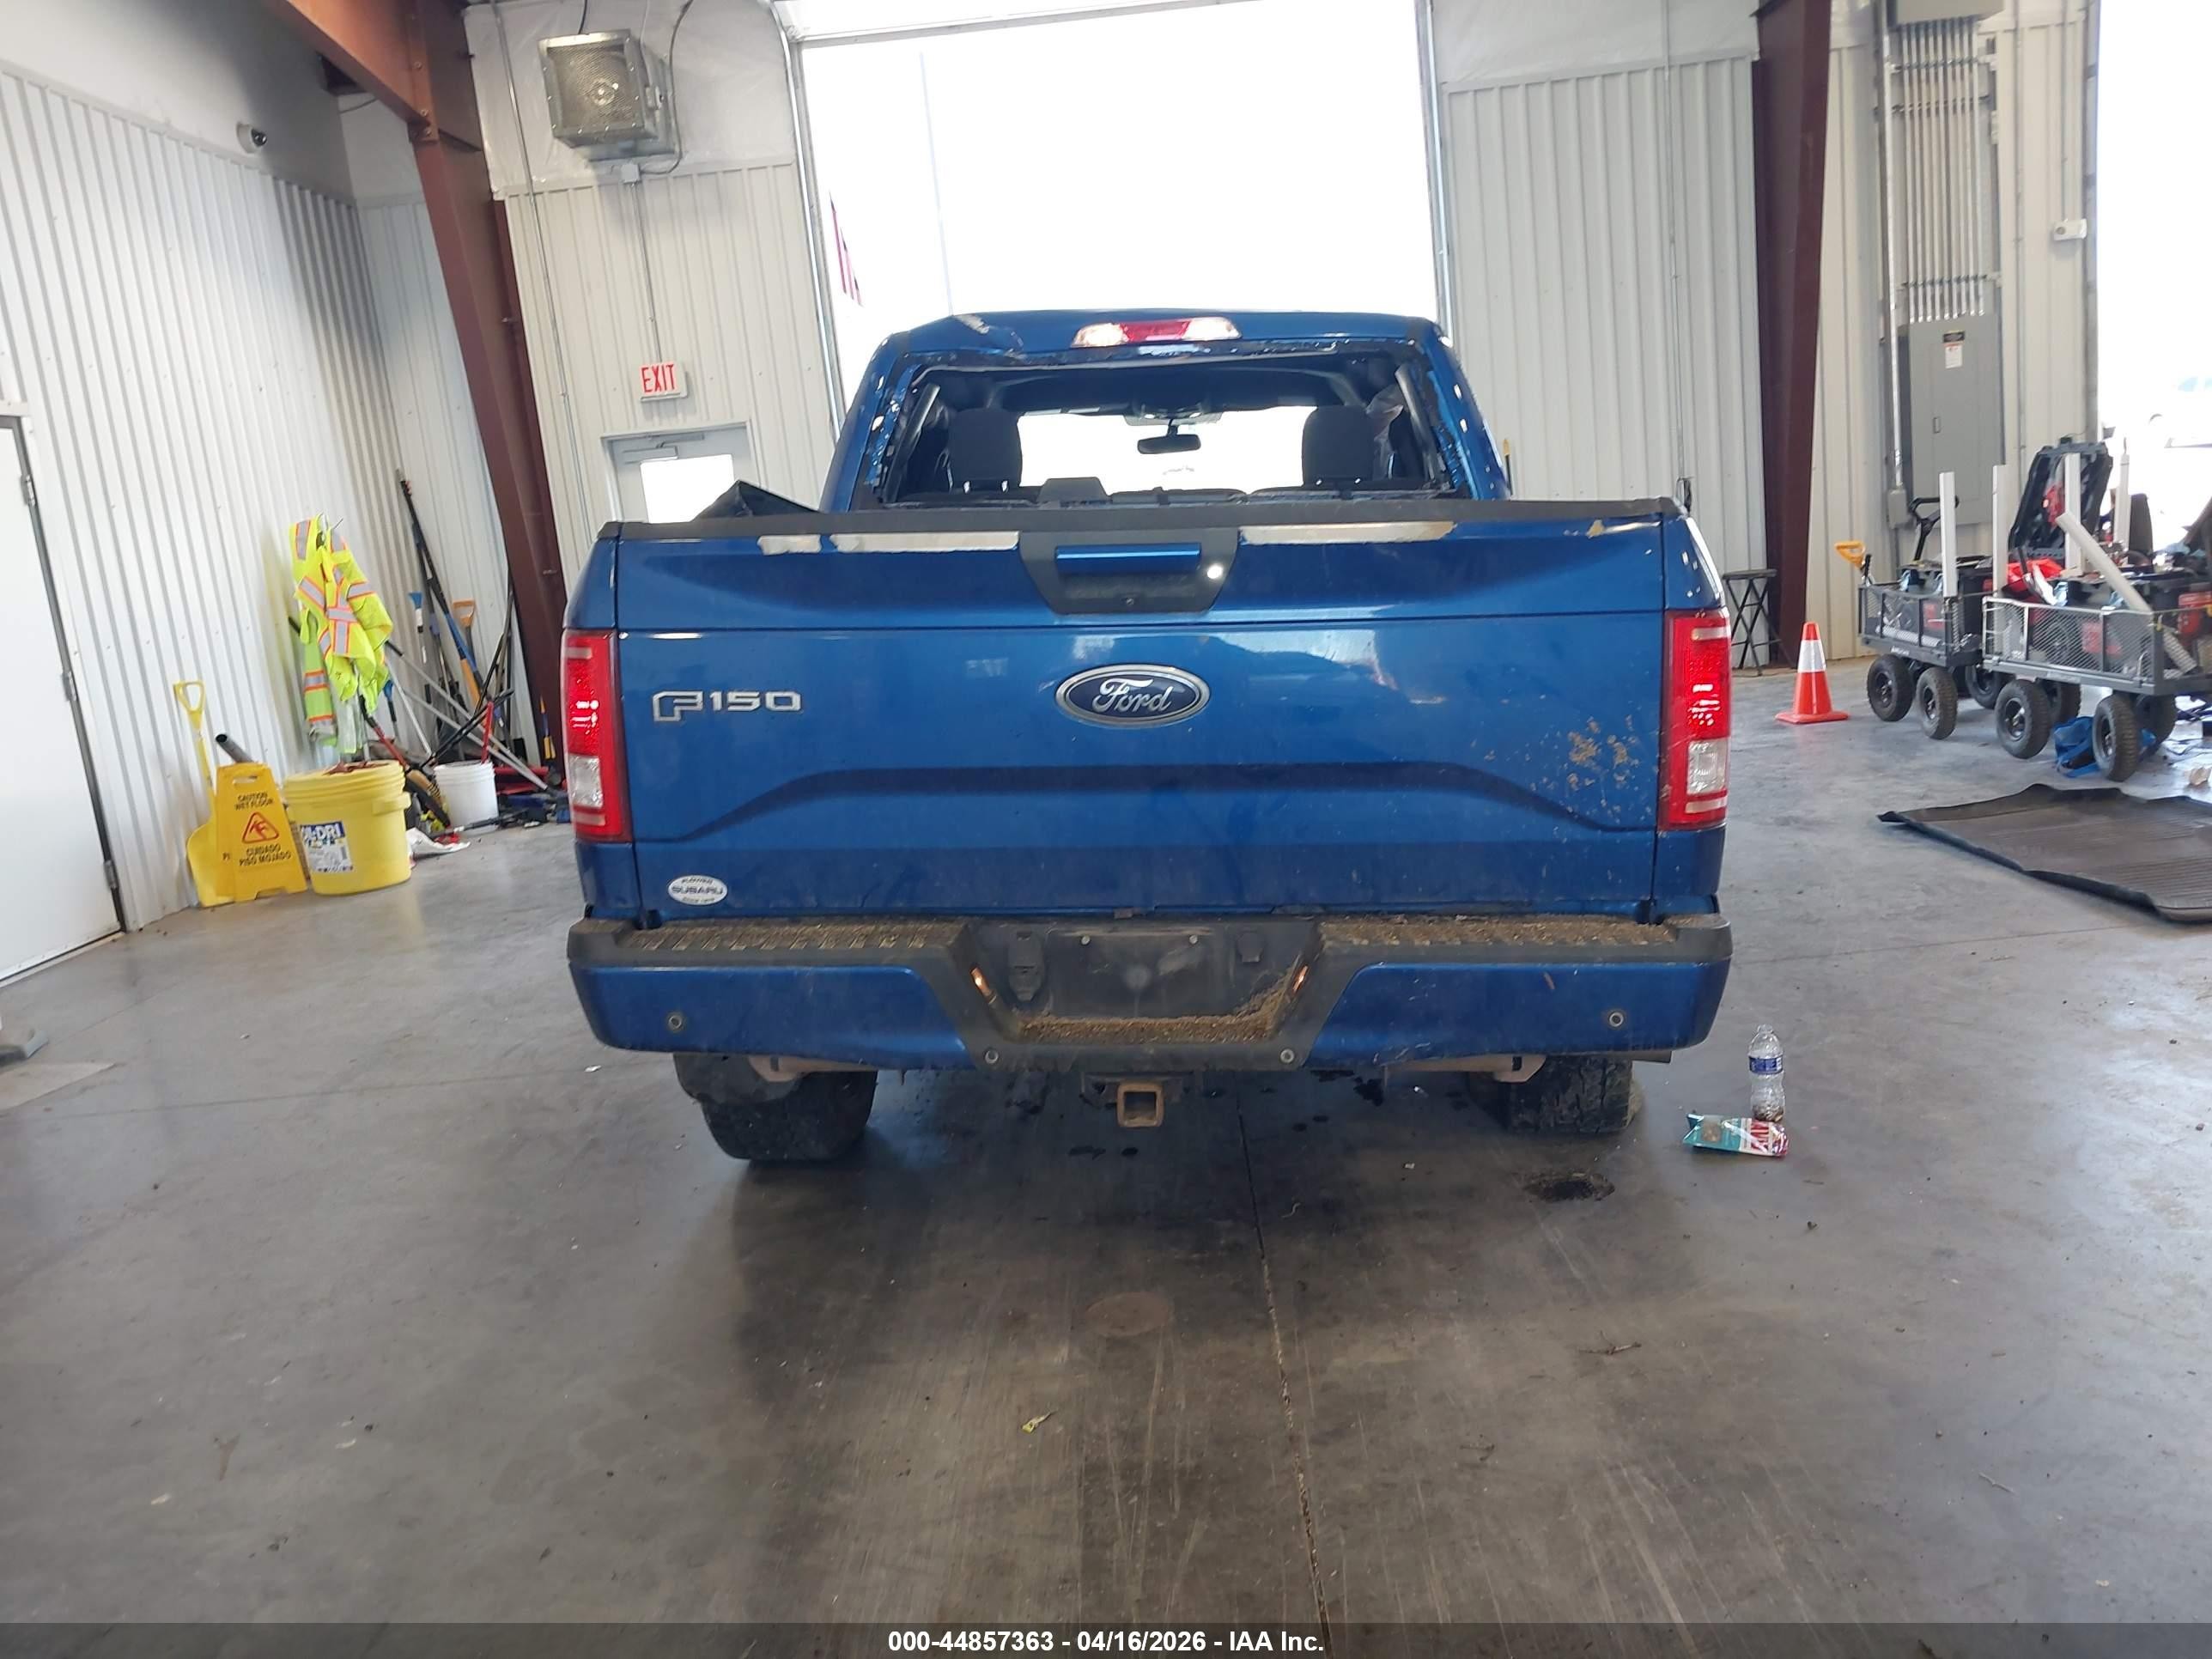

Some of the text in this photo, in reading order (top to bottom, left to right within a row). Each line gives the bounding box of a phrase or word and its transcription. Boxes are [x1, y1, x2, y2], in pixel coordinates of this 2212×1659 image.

[641, 364, 675, 393] EXIT
[1091, 678, 1174, 713] Ford
[237, 791, 269, 802] CAUTION
[235, 798, 274, 811] WET FLOOR
[246, 843, 282, 857] CUIDADO
[239, 850, 292, 866] PISO MOJADO
